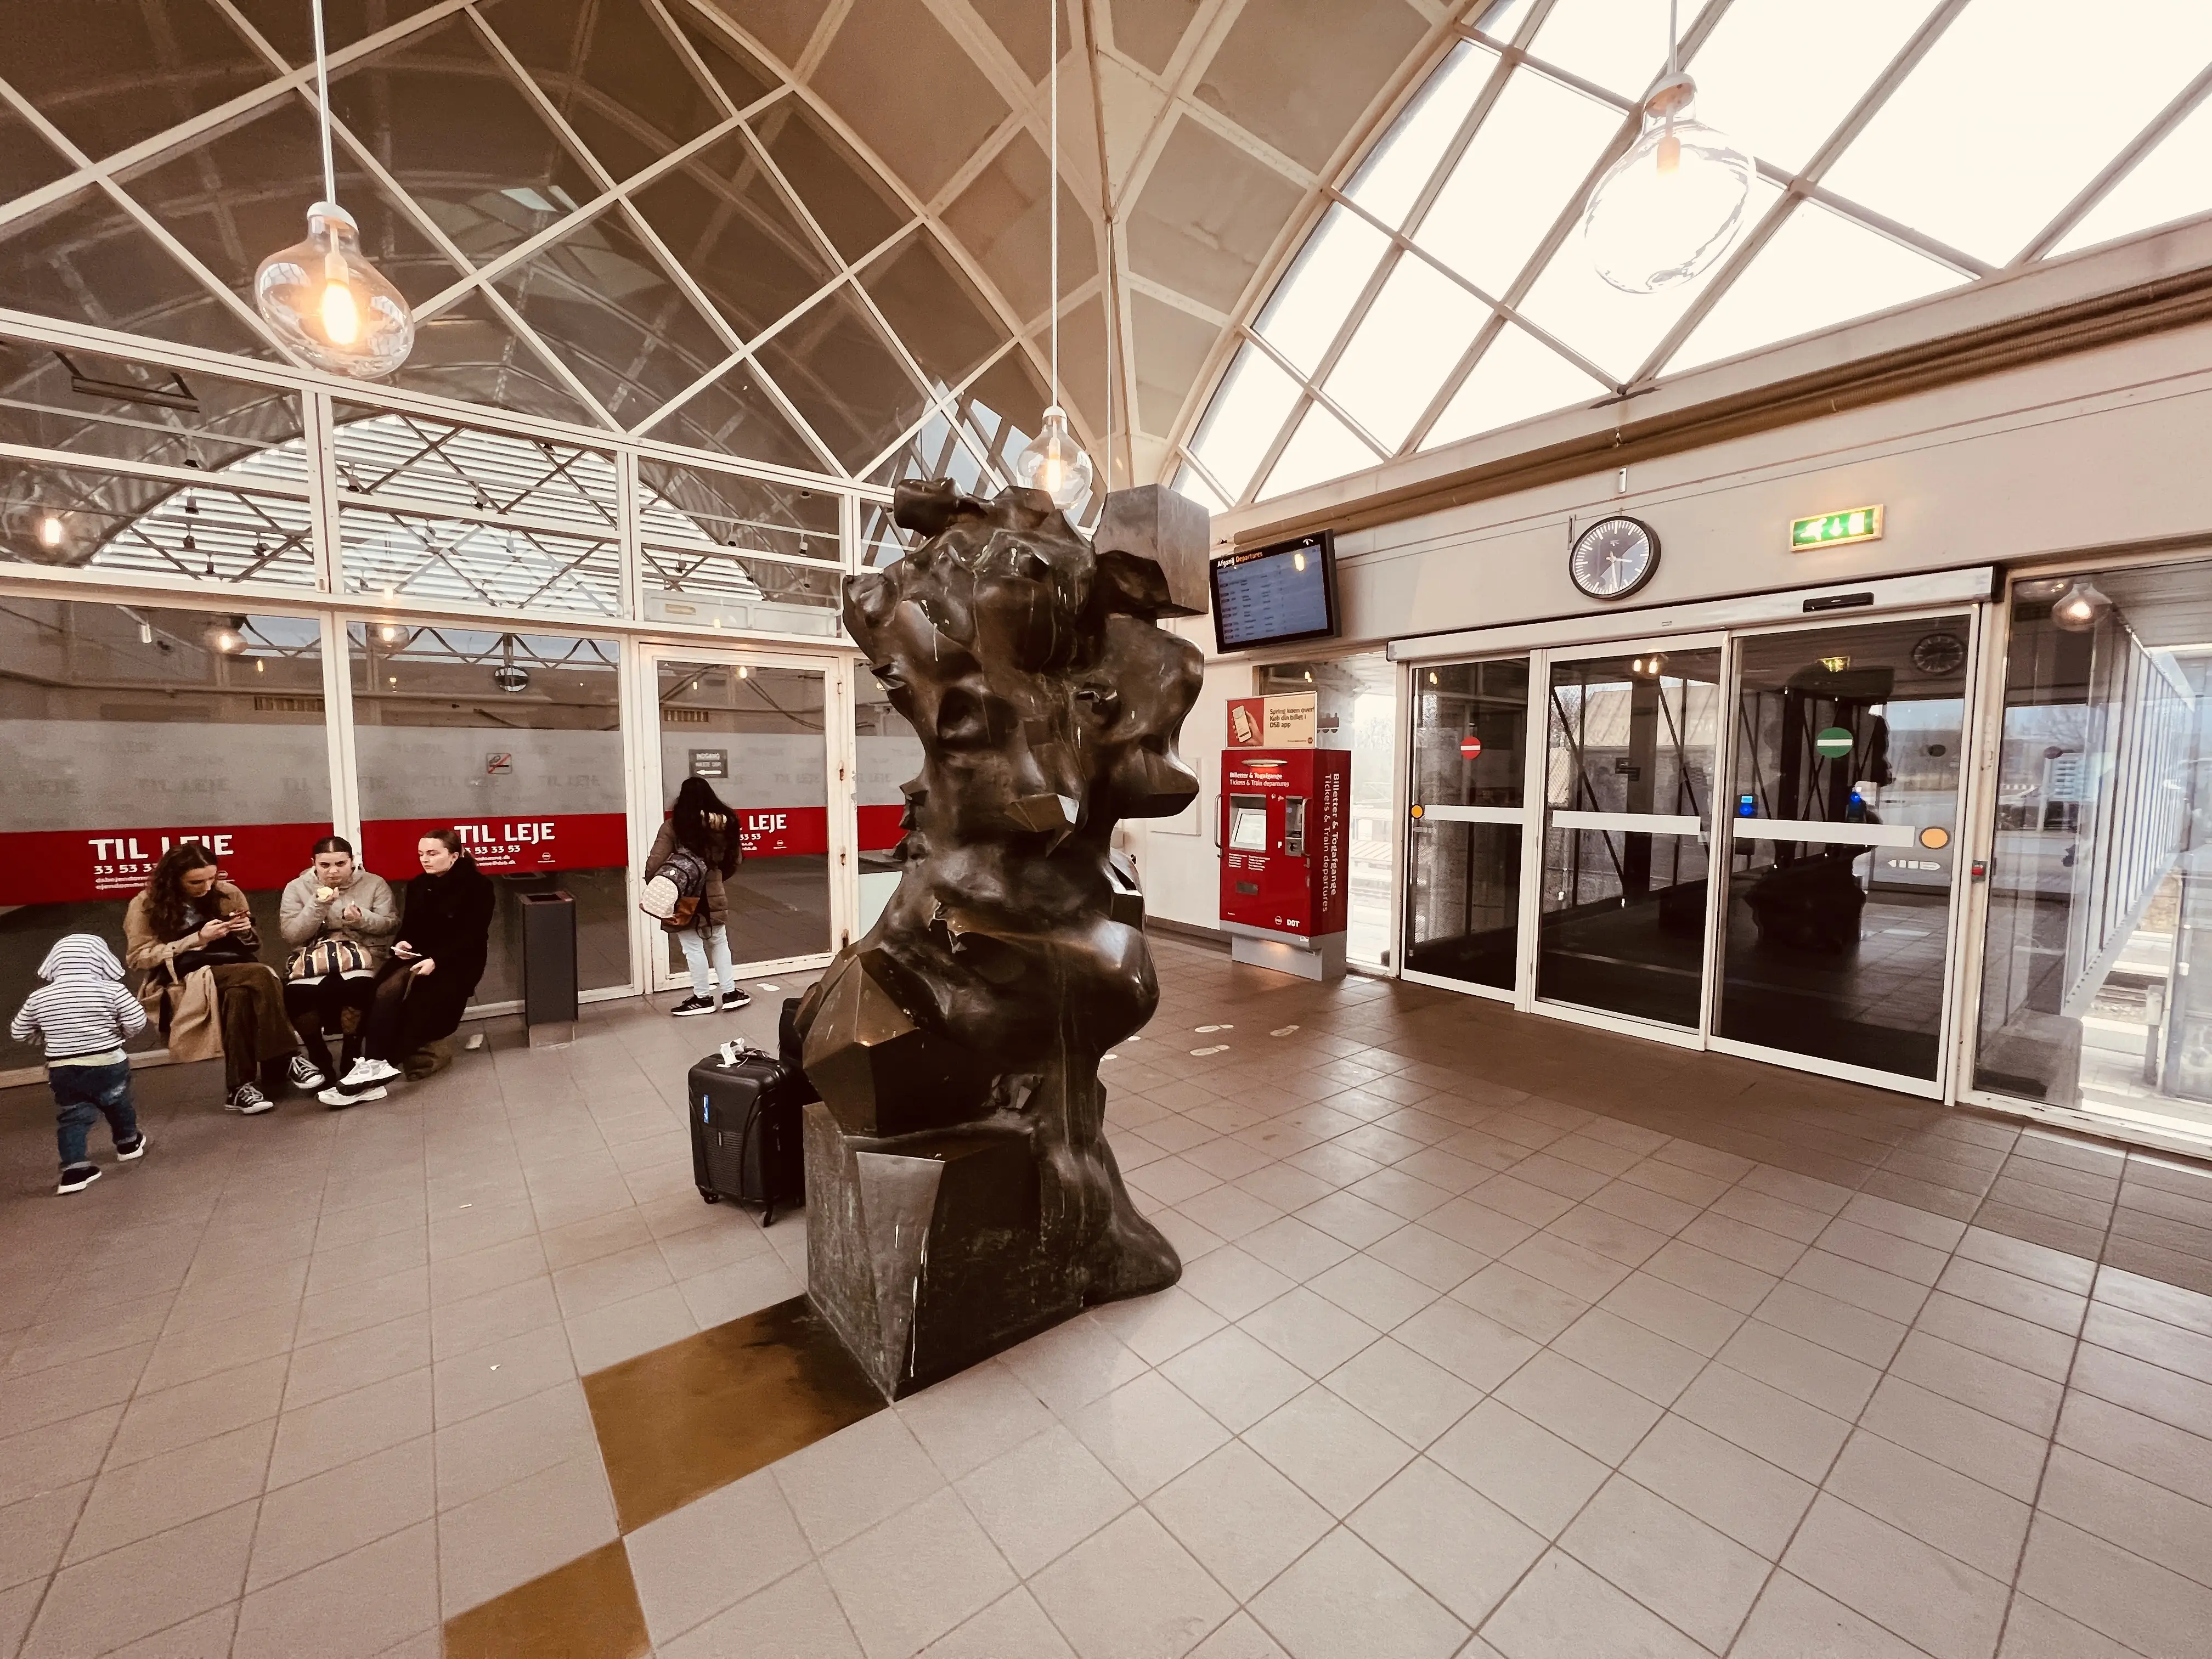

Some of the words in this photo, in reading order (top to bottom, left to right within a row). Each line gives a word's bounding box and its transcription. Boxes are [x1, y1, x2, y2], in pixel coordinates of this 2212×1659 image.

[1236, 552, 1263, 563] Departures
[454, 825, 496, 843] TIL
[504, 822, 555, 844] LEJE
[749, 814, 787, 833] LEJE
[88, 838, 149, 861] TIL
[161, 834, 234, 856] LE
[94, 865, 114, 874] 33
[119, 864, 138, 873] 53
[1330, 832, 1339, 895] Togafgange
[1286, 919, 1300, 927] DOT
